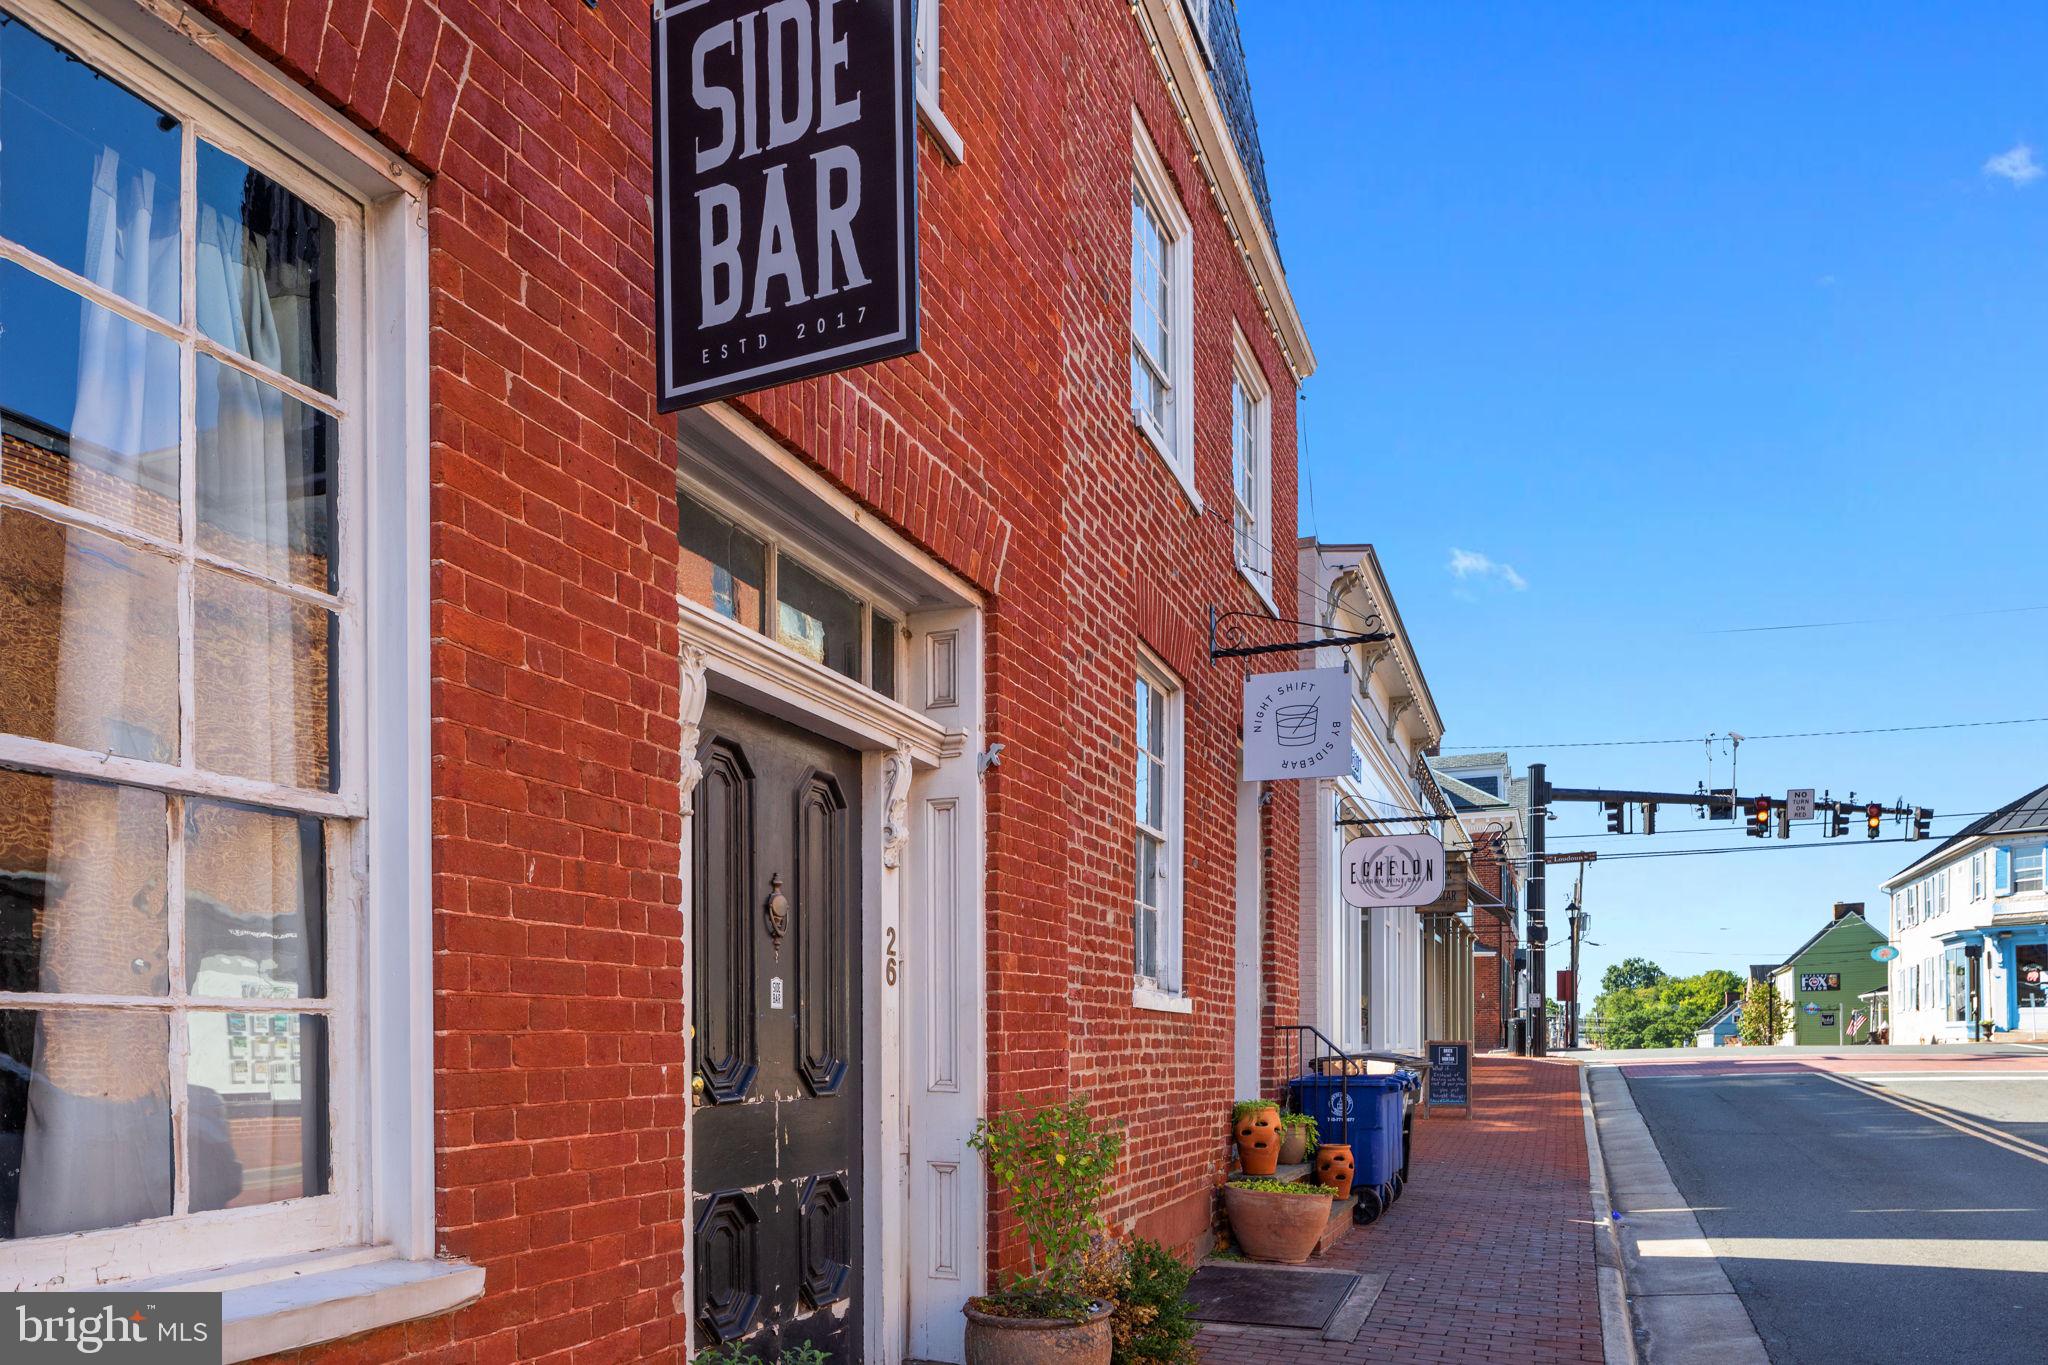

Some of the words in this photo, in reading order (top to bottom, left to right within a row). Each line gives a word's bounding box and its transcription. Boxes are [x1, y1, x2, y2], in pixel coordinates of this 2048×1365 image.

[691, 0, 861, 174] SIDE
[693, 145, 872, 330] BAR
[702, 334, 767, 364] ESTD
[797, 306, 866, 339] 2017
[1253, 694, 1273, 733] NIGHT
[1277, 681, 1316, 696] SHIFT
[1331, 721, 1341, 737] BY
[1281, 741, 1334, 769] SIDEBAR
[1350, 859, 1433, 884] ECHELON
[885, 926, 897, 987] 26
